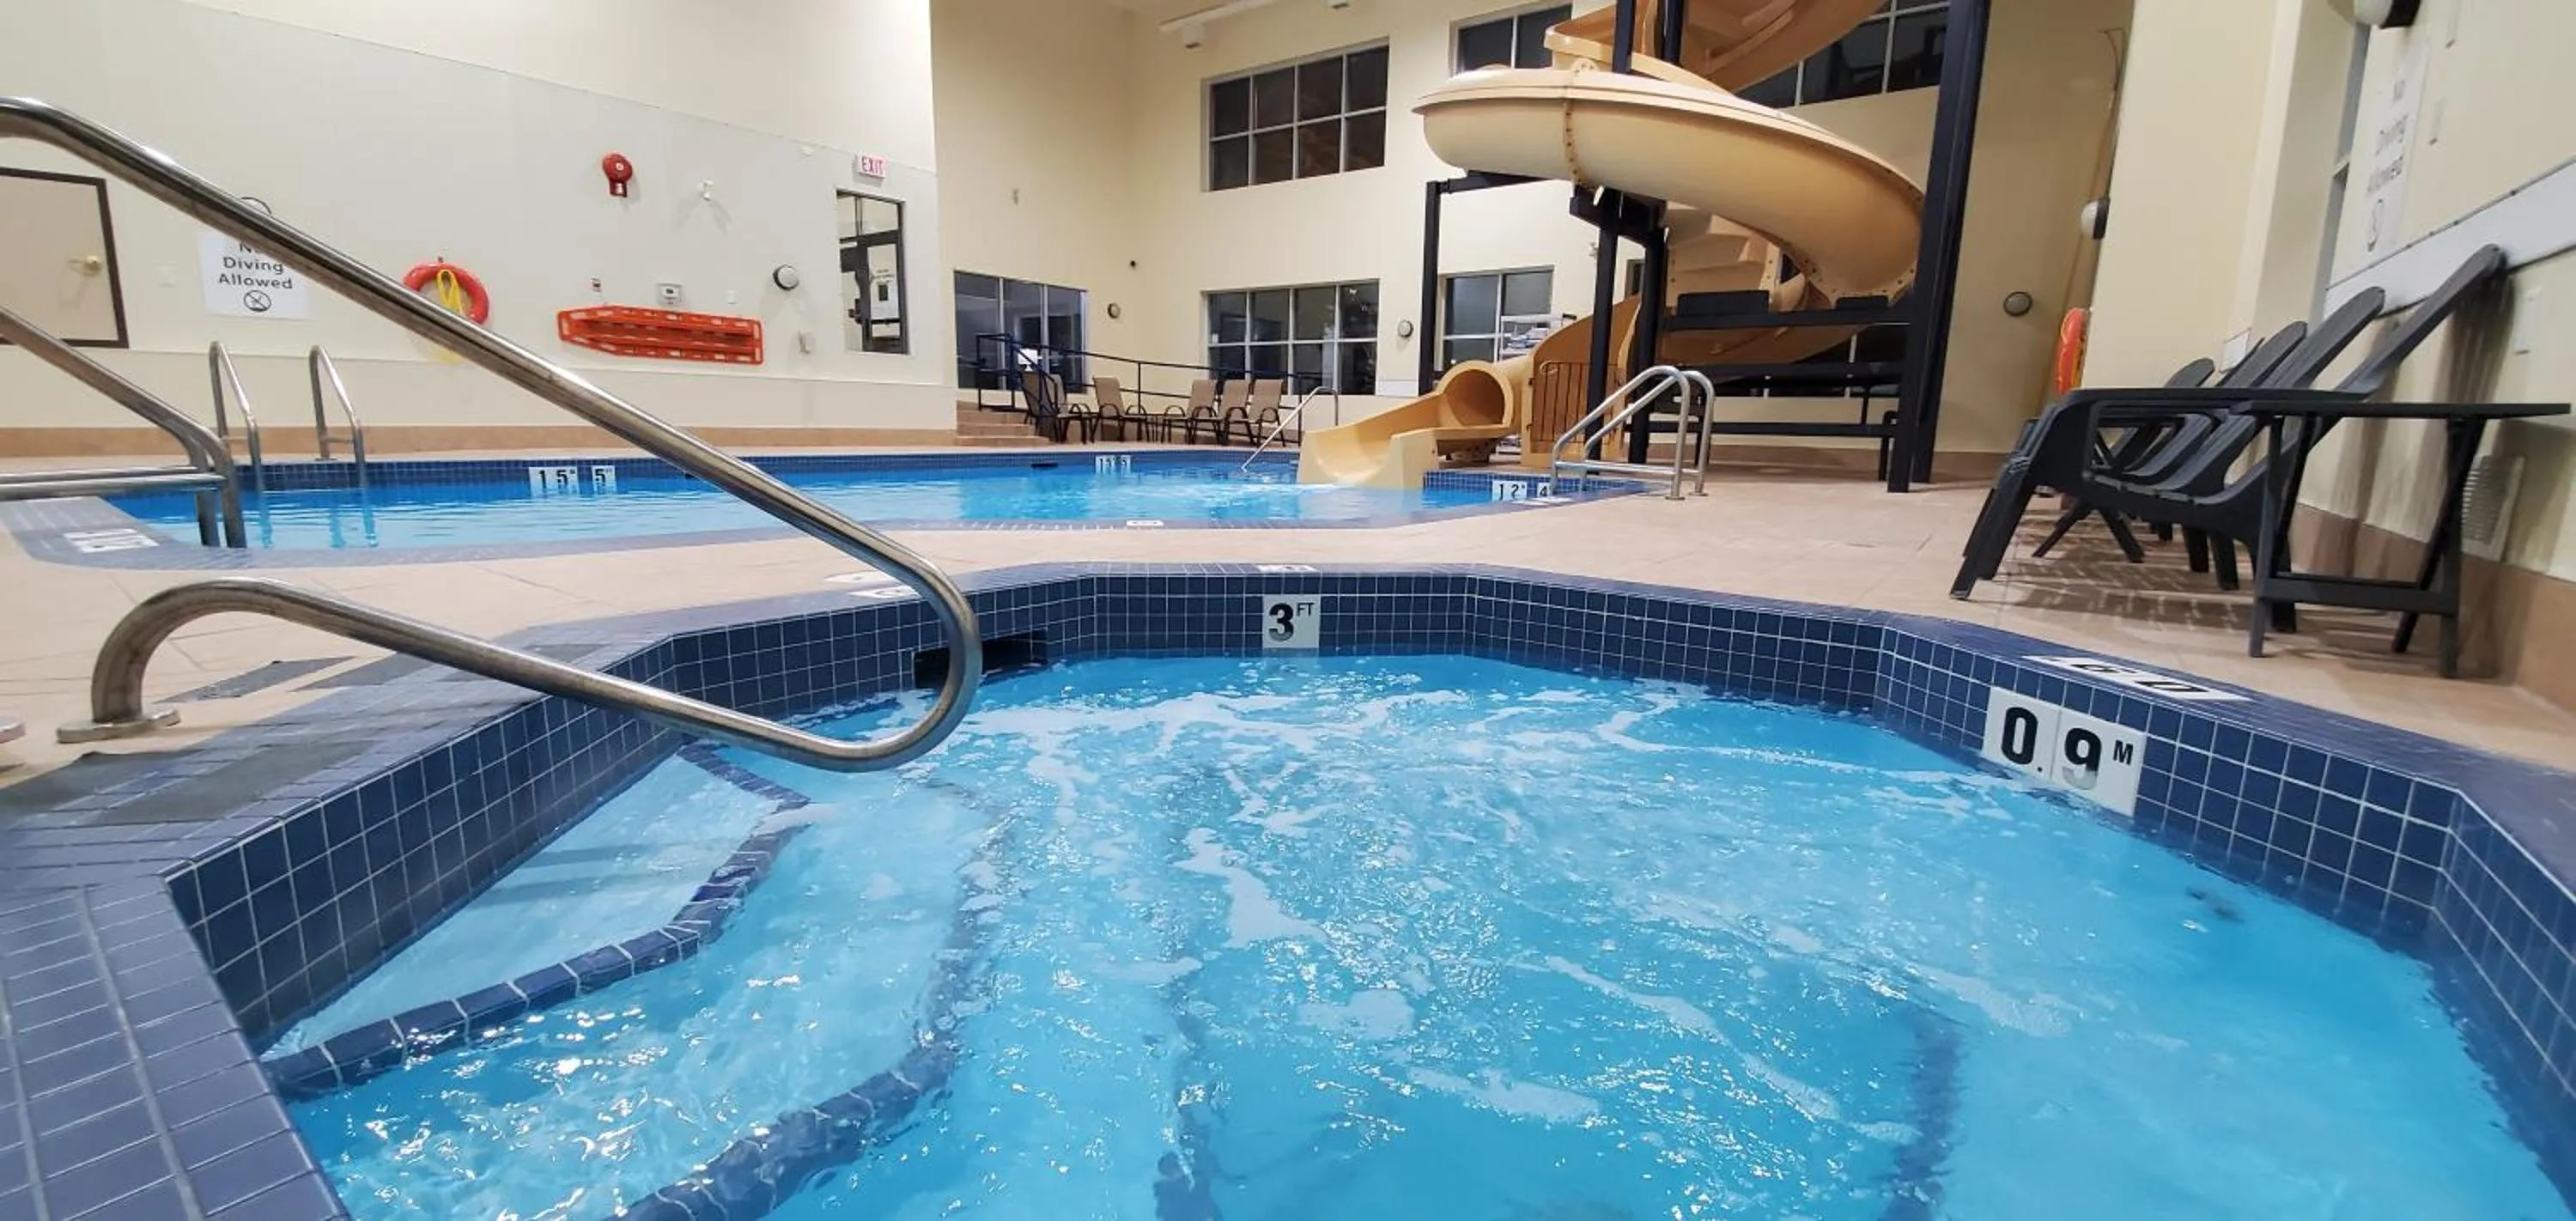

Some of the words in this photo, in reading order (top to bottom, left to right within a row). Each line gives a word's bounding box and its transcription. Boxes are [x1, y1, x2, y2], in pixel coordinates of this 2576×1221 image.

[861, 155, 884, 176] EXIT
[222, 256, 284, 275] Diving
[219, 274, 293, 289] Allowed
[1268, 603, 1295, 642] 3
[1296, 602, 1315, 617] FT
[2112, 739, 2135, 766] M
